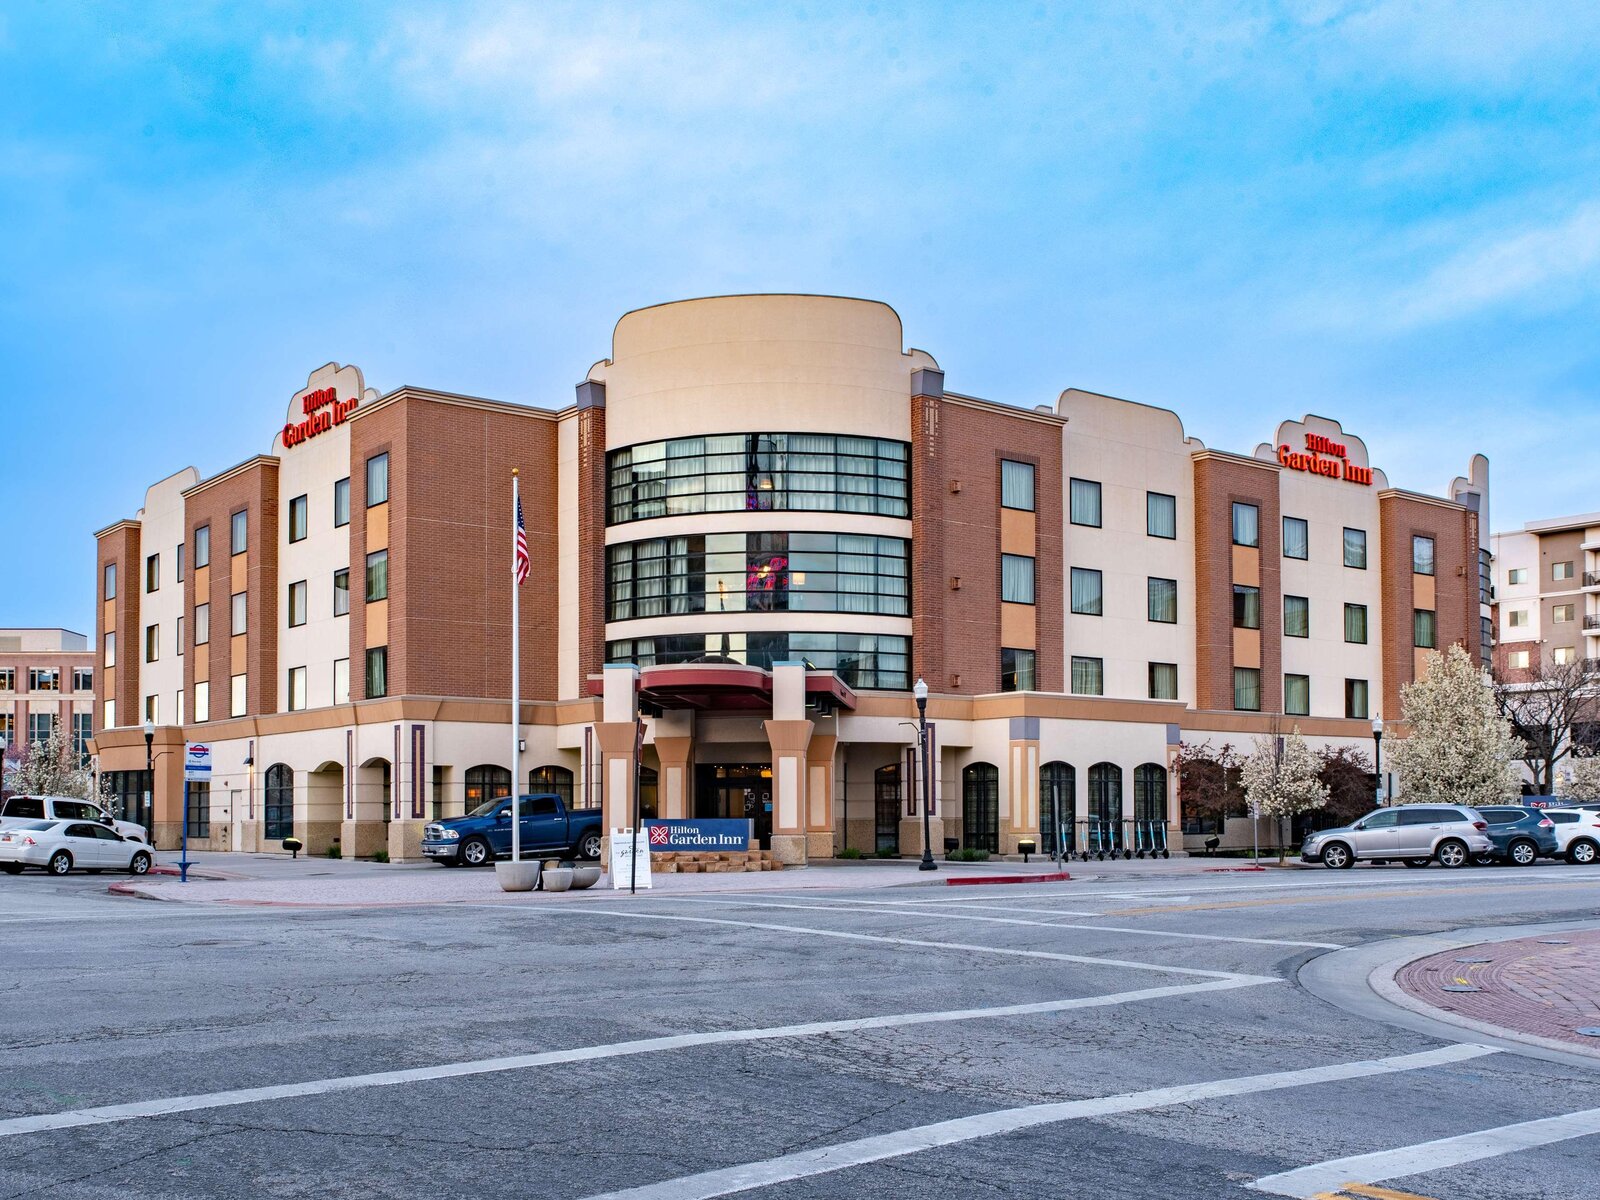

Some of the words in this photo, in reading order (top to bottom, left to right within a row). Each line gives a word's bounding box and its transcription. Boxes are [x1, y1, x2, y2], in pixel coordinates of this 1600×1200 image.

[302, 387, 337, 414] Hilton
[282, 411, 332, 448] Garden
[331, 398, 359, 426] Inn
[1305, 432, 1347, 458] Hilton
[1278, 444, 1341, 479] Garden
[1342, 458, 1373, 486] Inn
[669, 834, 717, 845] Garden
[719, 834, 742, 845] Inn
[670, 826, 699, 834] Hilton
